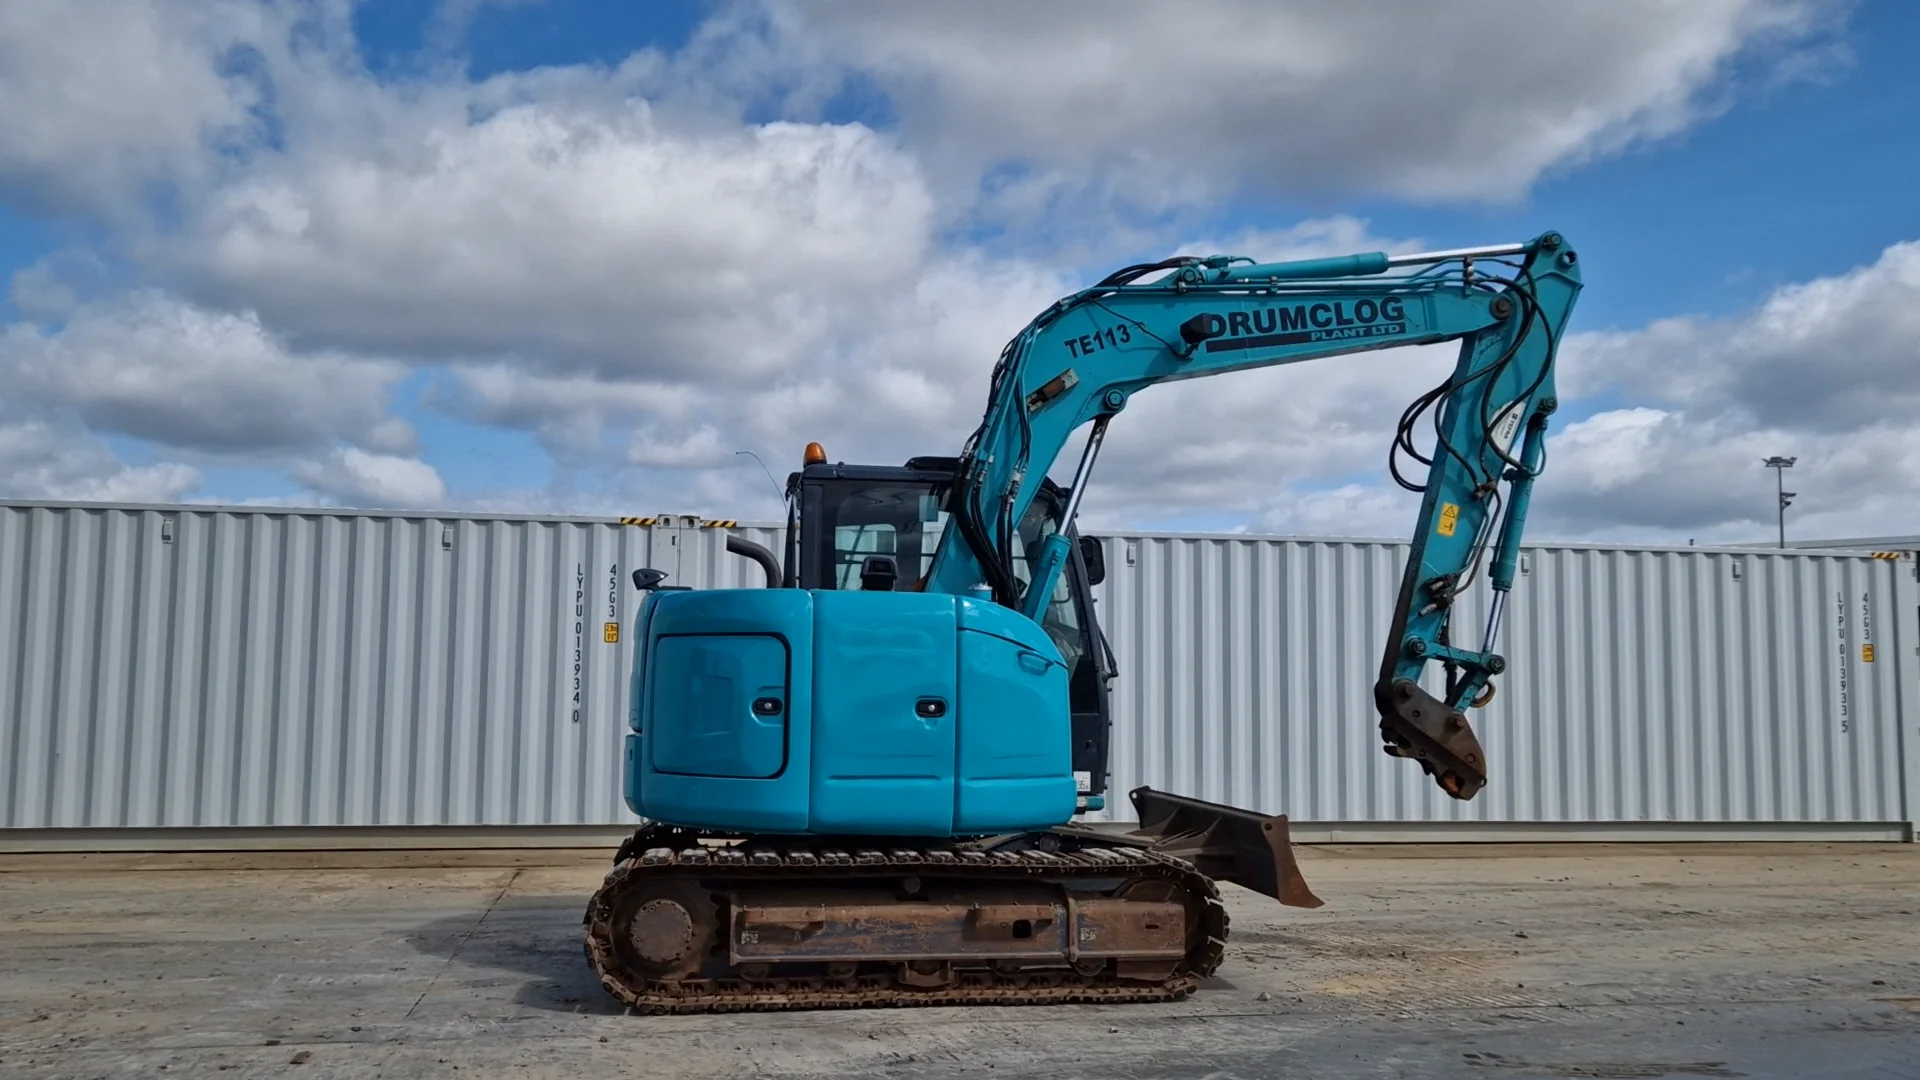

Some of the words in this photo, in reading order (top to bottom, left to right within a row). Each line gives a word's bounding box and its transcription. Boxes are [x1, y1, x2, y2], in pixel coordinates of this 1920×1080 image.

[1209, 297, 1405, 338] DRUMCLOG
[1310, 327, 1367, 342] PLANT
[1371, 324, 1402, 337] LTD
[1064, 323, 1132, 359] TE113
[608, 563, 617, 618] 45G3
